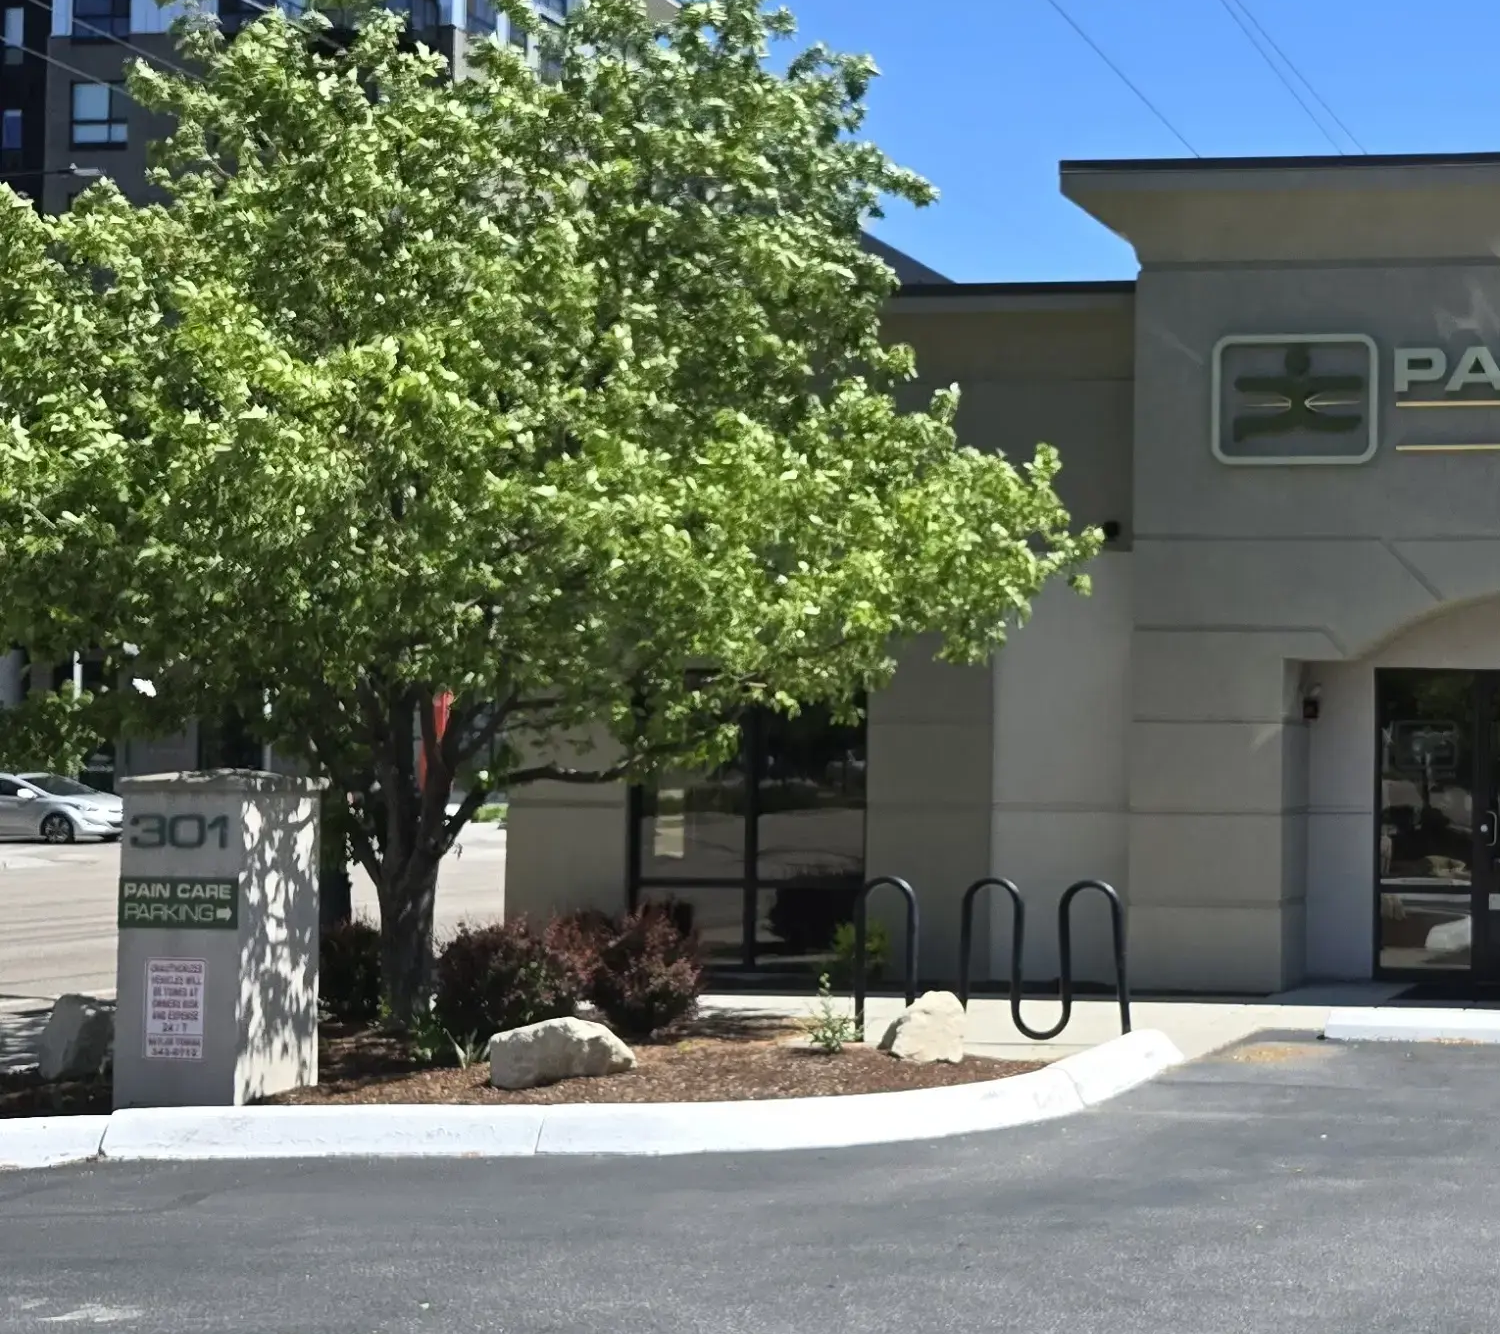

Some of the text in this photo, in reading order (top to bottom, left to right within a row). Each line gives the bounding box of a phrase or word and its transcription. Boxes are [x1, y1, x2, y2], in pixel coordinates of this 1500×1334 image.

[130, 813, 229, 849] 301
[123, 883, 232, 899] PAIN CARE
[123, 903, 214, 922] PARKING
